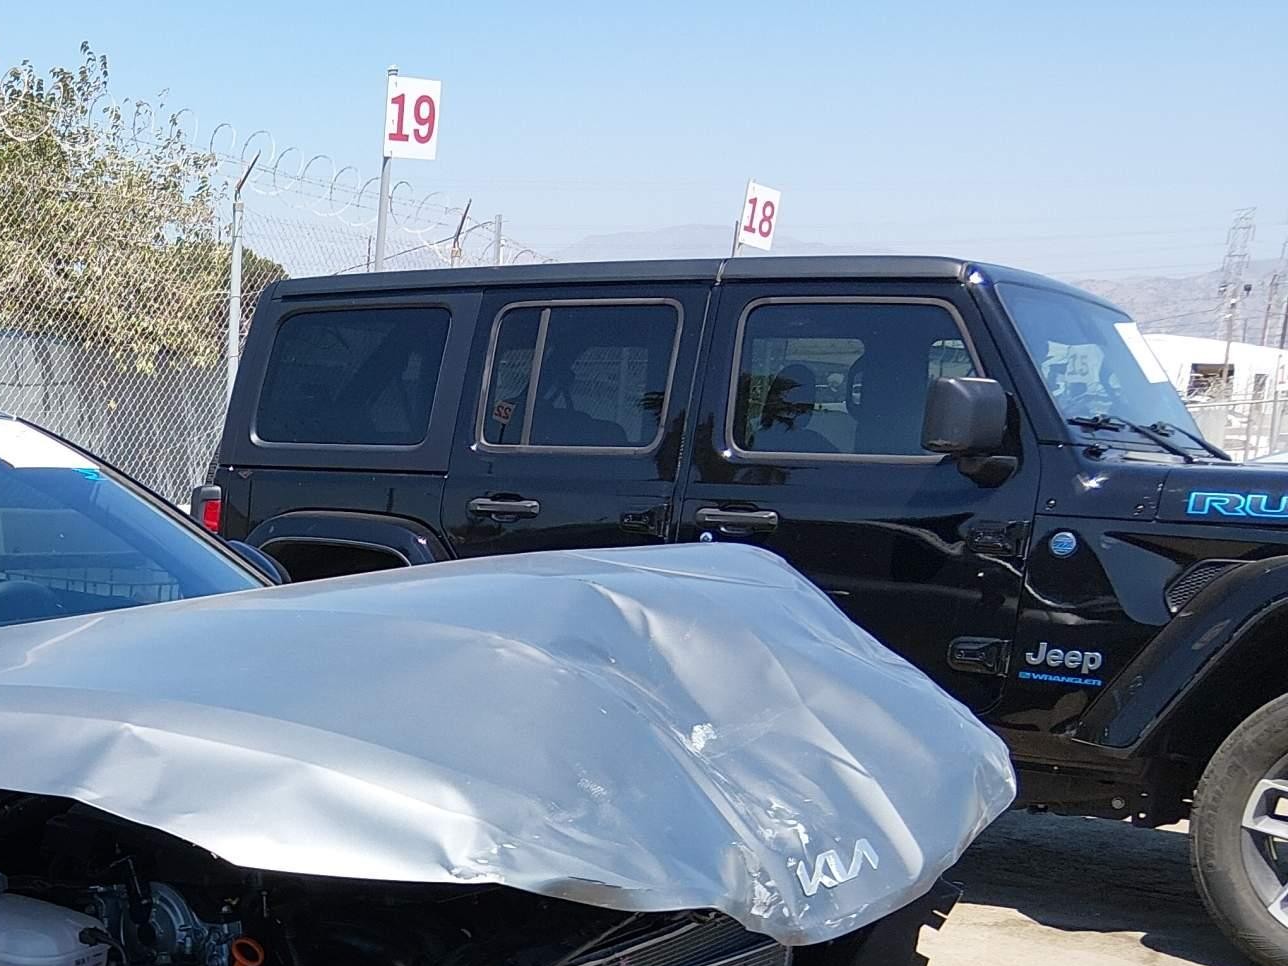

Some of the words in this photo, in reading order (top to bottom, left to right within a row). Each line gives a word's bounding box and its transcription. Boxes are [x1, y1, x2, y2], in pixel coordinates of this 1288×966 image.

[388, 93, 436, 144] 19
[743, 196, 775, 238] 18
[1024, 642, 1103, 675] Jeep
[1032, 672, 1103, 687] WRANGLER
[796, 838, 880, 897] KIA
